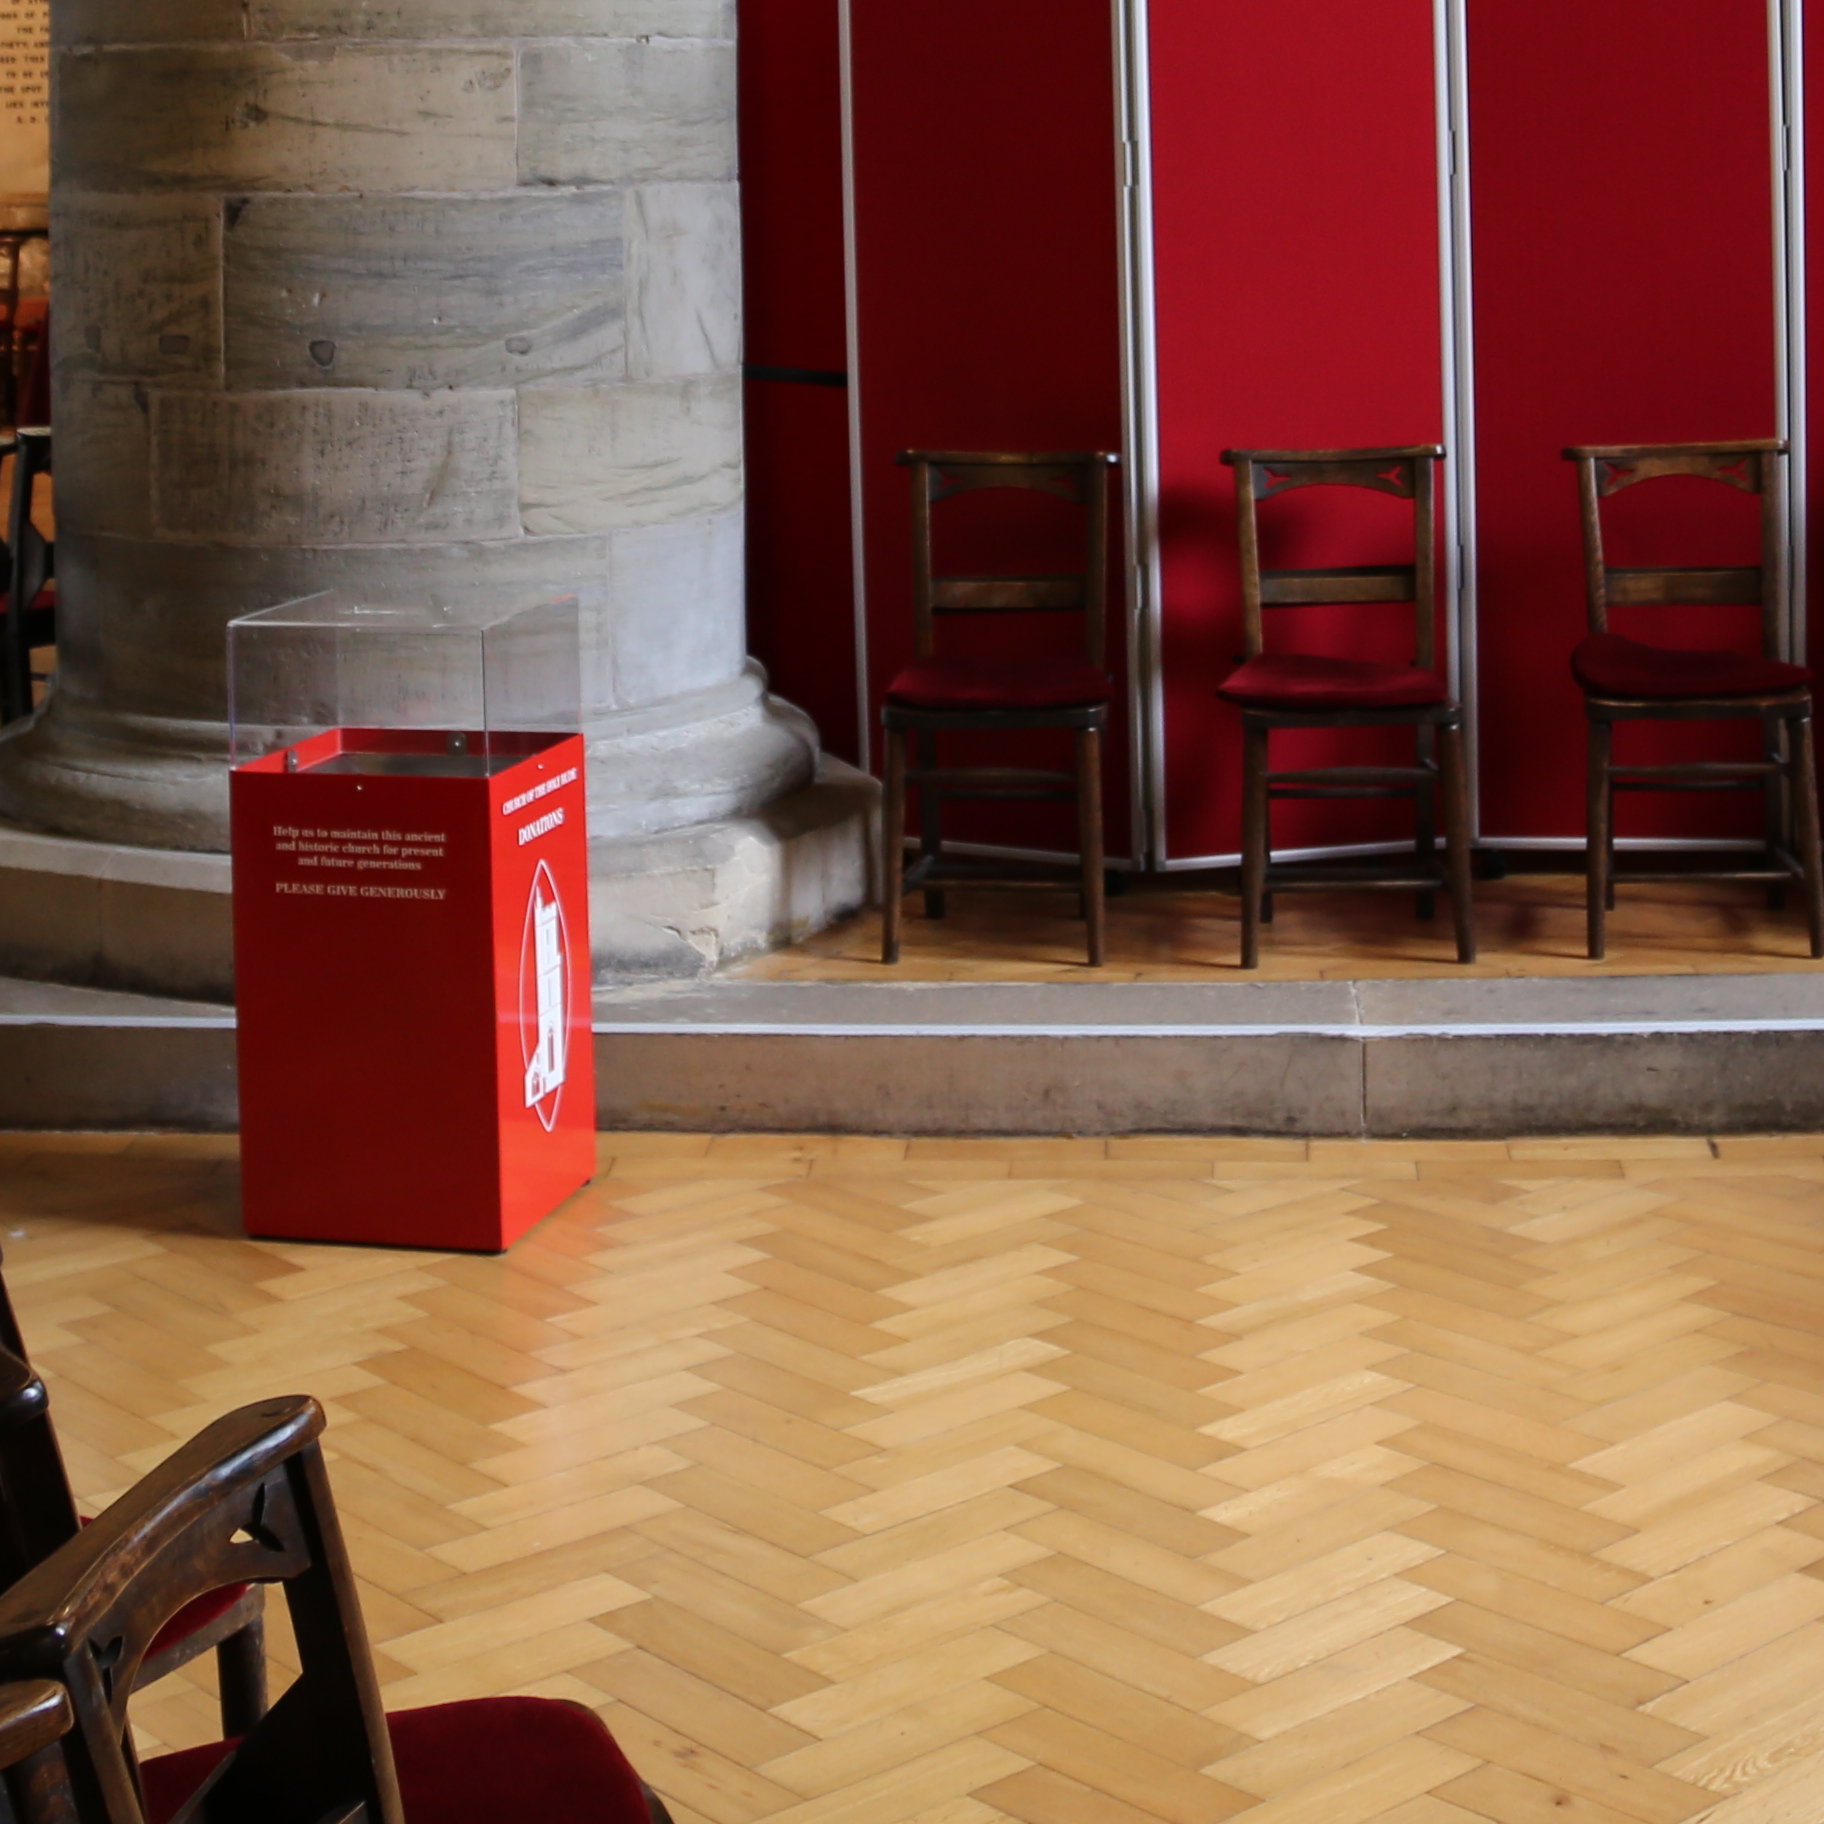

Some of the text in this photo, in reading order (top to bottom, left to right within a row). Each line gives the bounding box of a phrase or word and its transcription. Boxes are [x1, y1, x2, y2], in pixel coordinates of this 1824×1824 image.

[502, 792, 527, 815] CHURCH
[526, 788, 536, 804] OF
[534, 781, 547, 799] THE
[273, 826, 447, 842] Help us to maintain this ancient
[518, 807, 565, 846] DONATIONS
[275, 841, 444, 858] and historic church for present
[298, 856, 422, 871] and future generations
[275, 882, 447, 900] PLEASE GIVE GENEROUSLY
